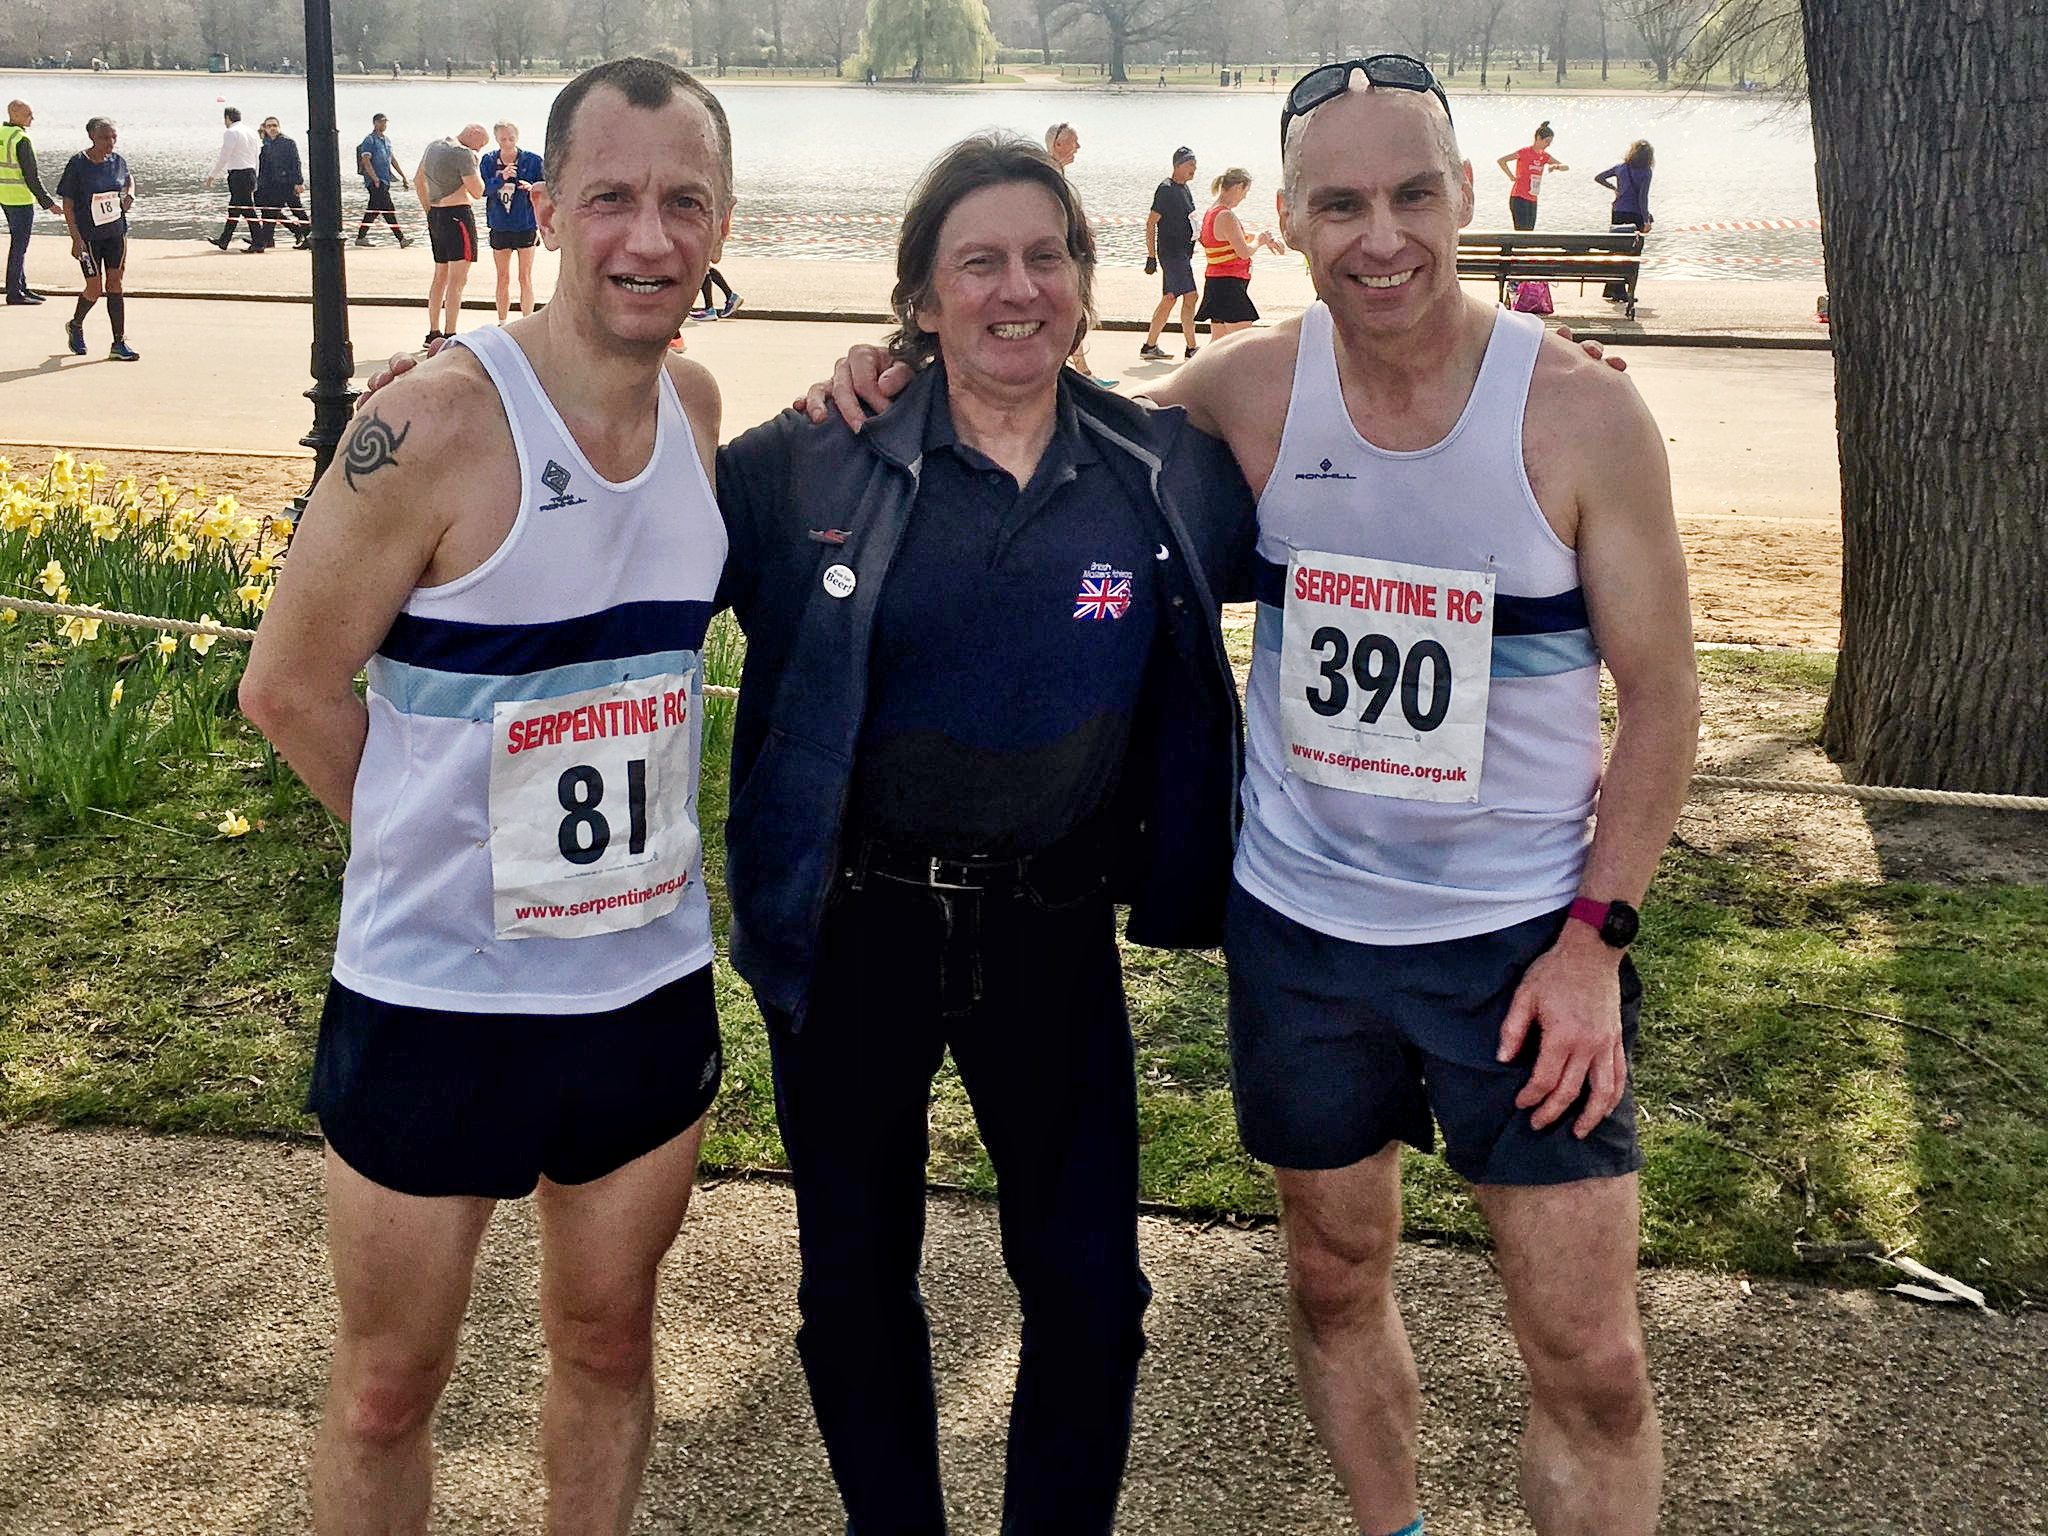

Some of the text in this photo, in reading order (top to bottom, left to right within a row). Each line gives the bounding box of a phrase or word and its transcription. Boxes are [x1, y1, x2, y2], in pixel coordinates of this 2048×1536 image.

[100, 201, 113, 214] 18
[826, 572, 852, 592] Beer!
[1295, 566, 1483, 624] SERPENTINE RC
[1305, 626, 1452, 732] 390
[507, 688, 687, 754] SERPENTINE RC
[1291, 743, 1467, 783] www.serpentine.org.uk
[558, 759, 647, 865] 81
